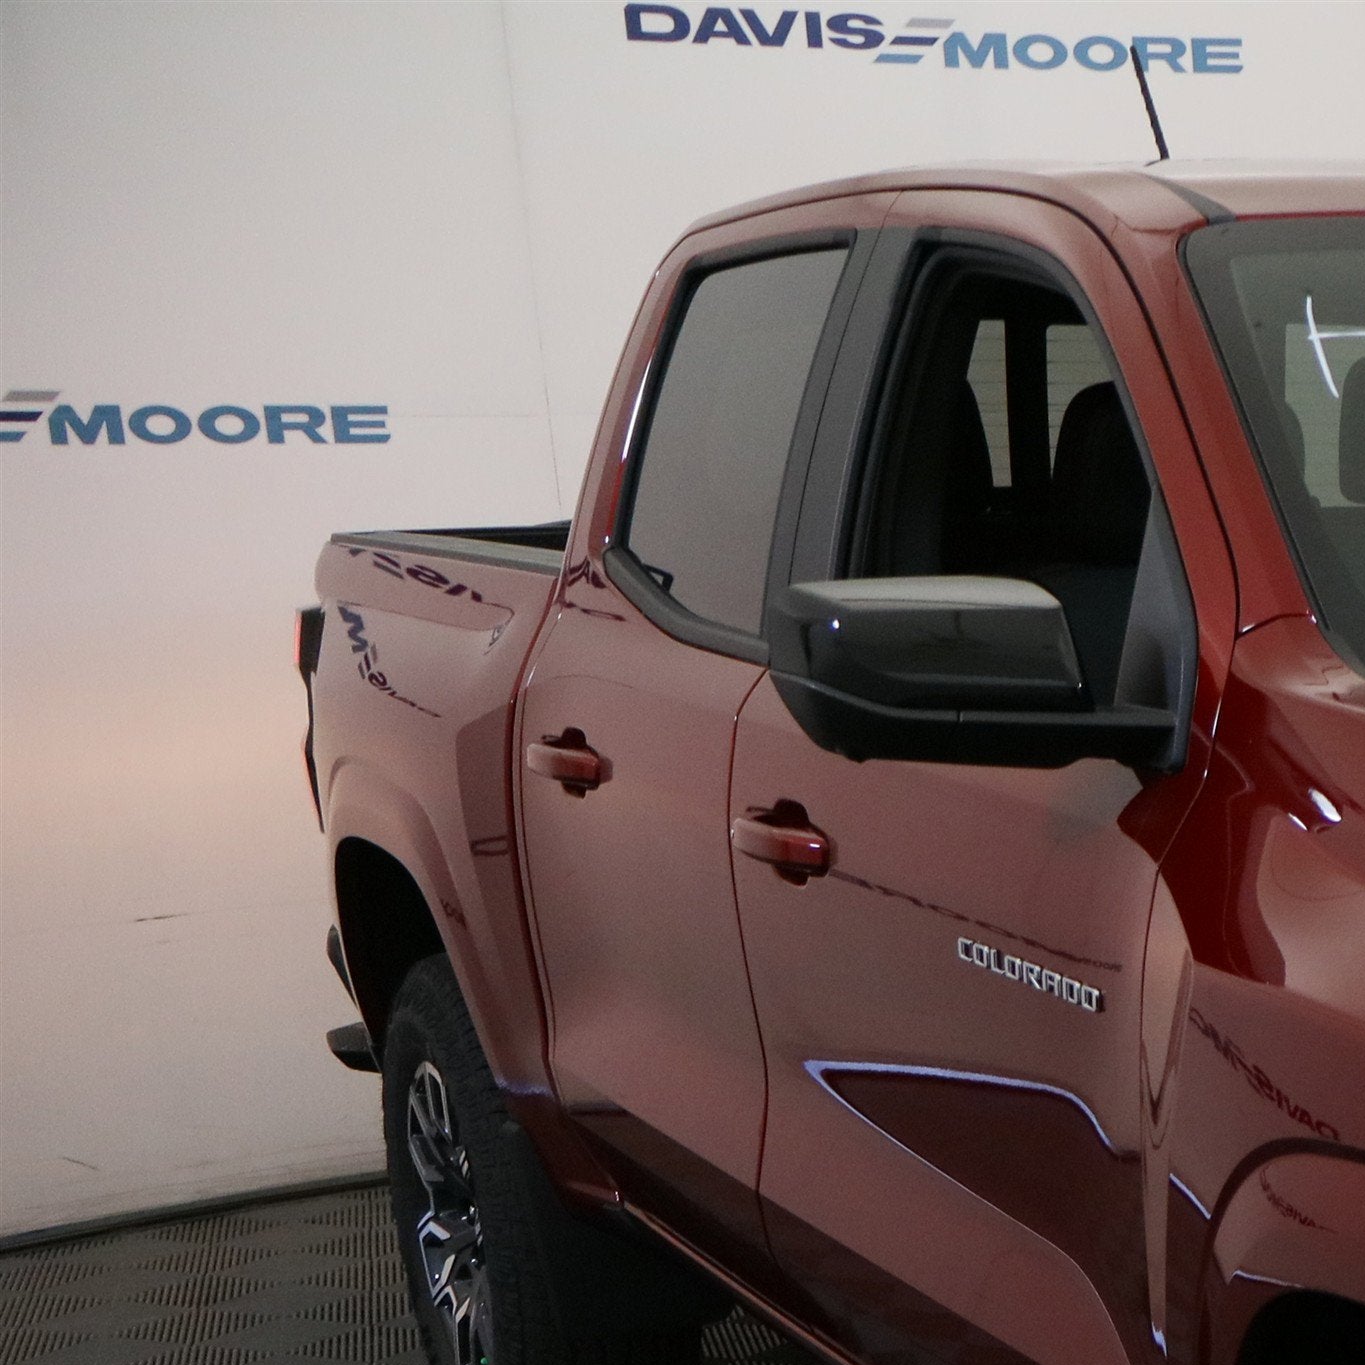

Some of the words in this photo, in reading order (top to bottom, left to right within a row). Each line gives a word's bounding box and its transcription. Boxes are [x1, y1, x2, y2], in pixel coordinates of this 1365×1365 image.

[624, 3, 888, 51] DAVIS
[942, 31, 1243, 74] MOORE
[48, 404, 391, 445] MOORE
[957, 936, 1102, 1013] COLORADO
